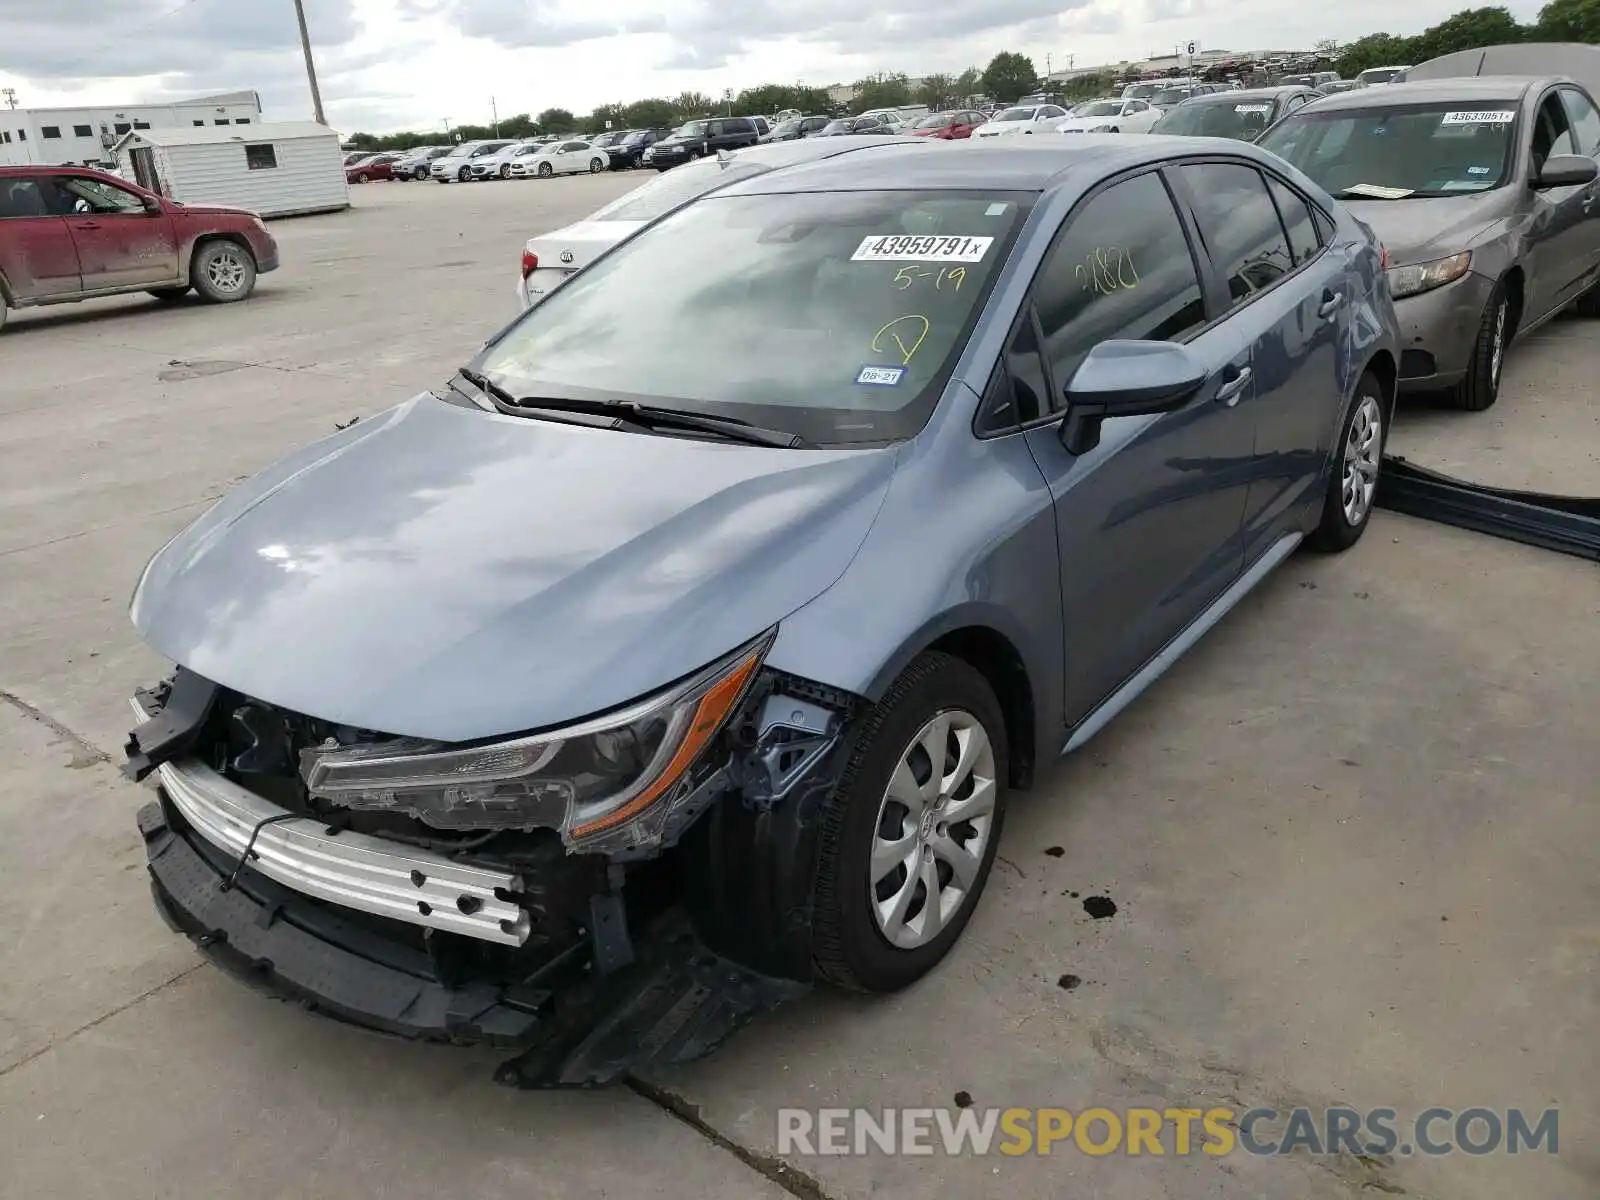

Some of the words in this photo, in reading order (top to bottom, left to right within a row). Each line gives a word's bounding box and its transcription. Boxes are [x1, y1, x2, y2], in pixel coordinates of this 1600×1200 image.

[1187, 42, 1195, 55] 6
[871, 236, 972, 256] 43959791
[894, 265, 968, 291] 5-19
